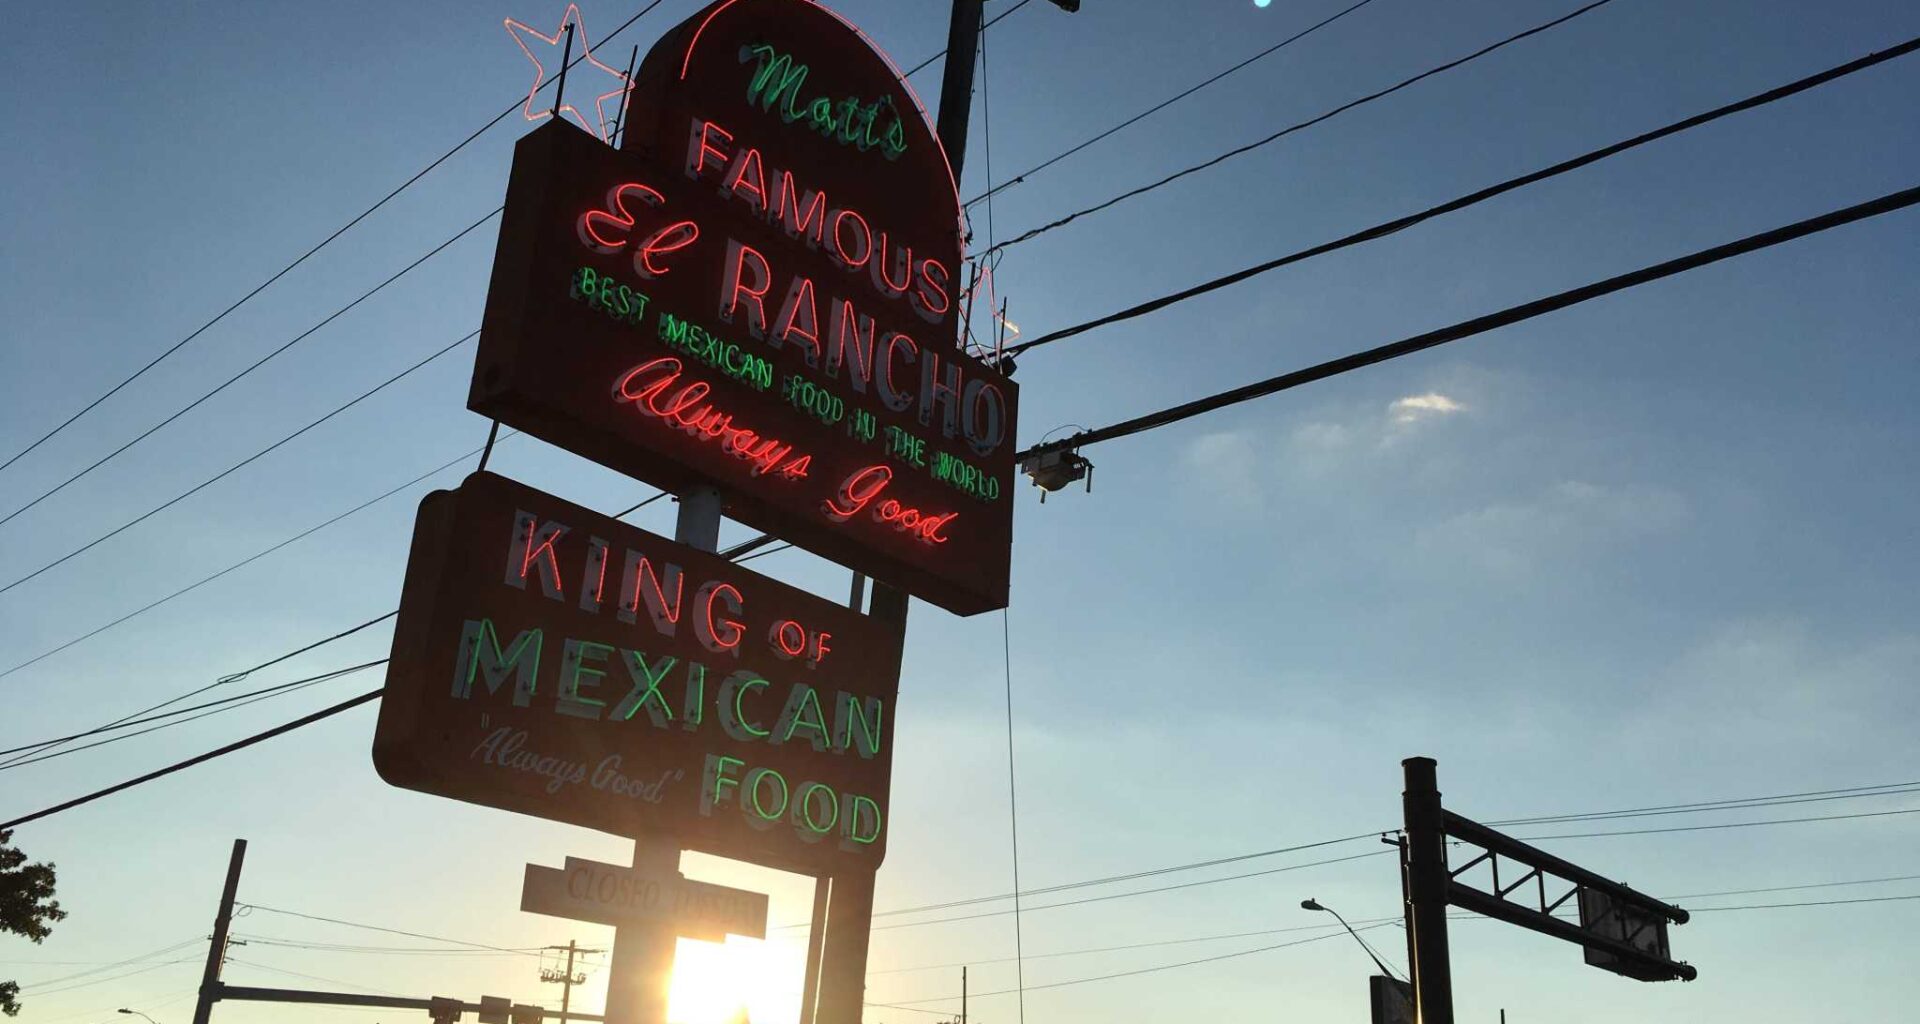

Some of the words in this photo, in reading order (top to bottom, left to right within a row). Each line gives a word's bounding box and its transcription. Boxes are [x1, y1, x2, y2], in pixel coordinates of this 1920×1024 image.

[738, 44, 908, 160] Matt's
[685, 117, 950, 322] FAMOUS
[569, 266, 650, 324] BEST
[658, 311, 774, 391] MEXICAN
[783, 374, 844, 427] FOOD
[848, 407, 877, 442] IN
[884, 424, 926, 468] THE
[931, 449, 1000, 501] WORLD
[577, 183, 699, 279] El
[718, 236, 1006, 457] RANCHO
[611, 356, 812, 482] Always
[822, 464, 958, 545] Good
[505, 508, 746, 658] KING
[768, 619, 832, 670] OF
[450, 618, 883, 760] MEXICAN
[700, 752, 882, 854] FOOD
